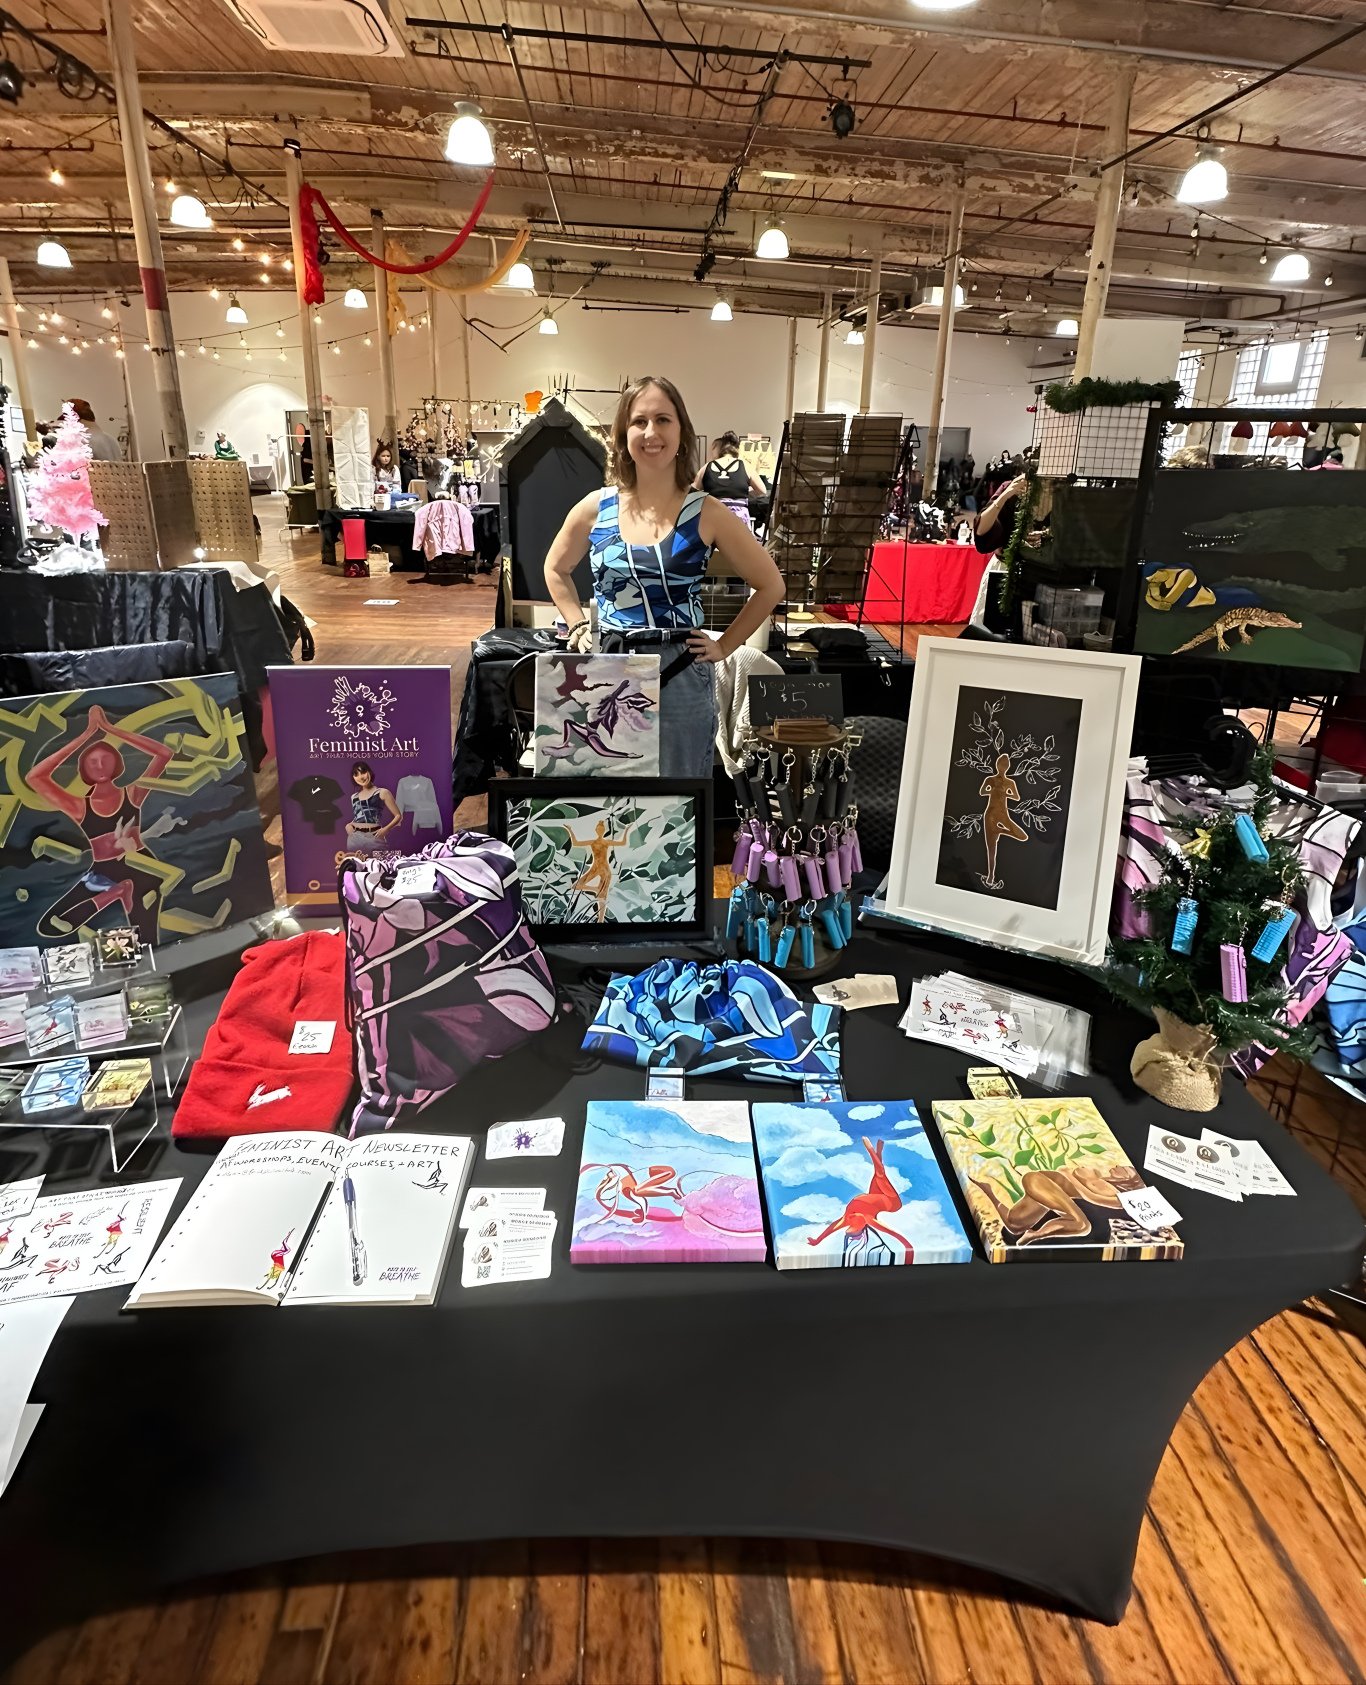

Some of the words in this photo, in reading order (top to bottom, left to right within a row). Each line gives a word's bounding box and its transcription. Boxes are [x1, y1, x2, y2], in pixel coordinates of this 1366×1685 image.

[308, 736, 388, 752] Feminist
[390, 736, 420, 752] Art
[321, 1140, 361, 1162] ART
[365, 1140, 461, 1157] NEWSLETTER
[407, 1160, 435, 1169] ART
